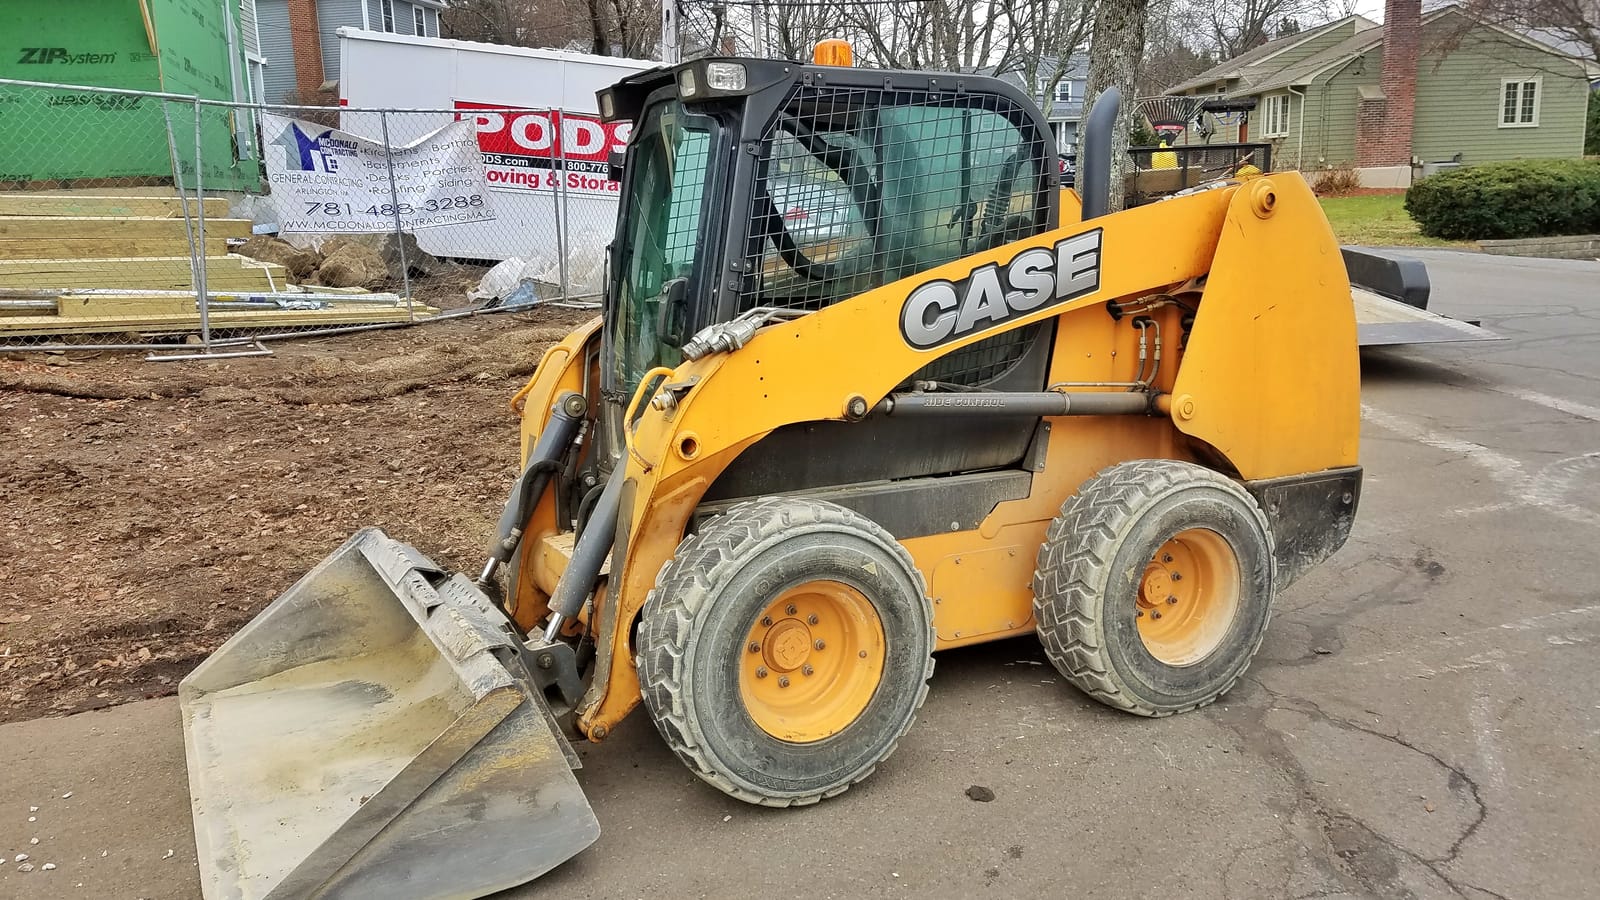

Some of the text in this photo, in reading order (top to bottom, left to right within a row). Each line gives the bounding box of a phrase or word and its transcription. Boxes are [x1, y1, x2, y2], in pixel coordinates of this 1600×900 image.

[318, 137, 358, 149] MCDONALD
[320, 145, 358, 157] CONTRACTING
[423, 165, 473, 178] Porches
[567, 162, 608, 173] 800-776
[271, 173, 364, 188] GENERAL CONTRACTING
[438, 178, 473, 189] Siding
[483, 167, 540, 188] oving
[546, 172, 560, 188] &
[304, 194, 485, 216] 781-488-3288
[903, 231, 1101, 347] CASE
[924, 397, 1006, 407] RIDE CONTROL
